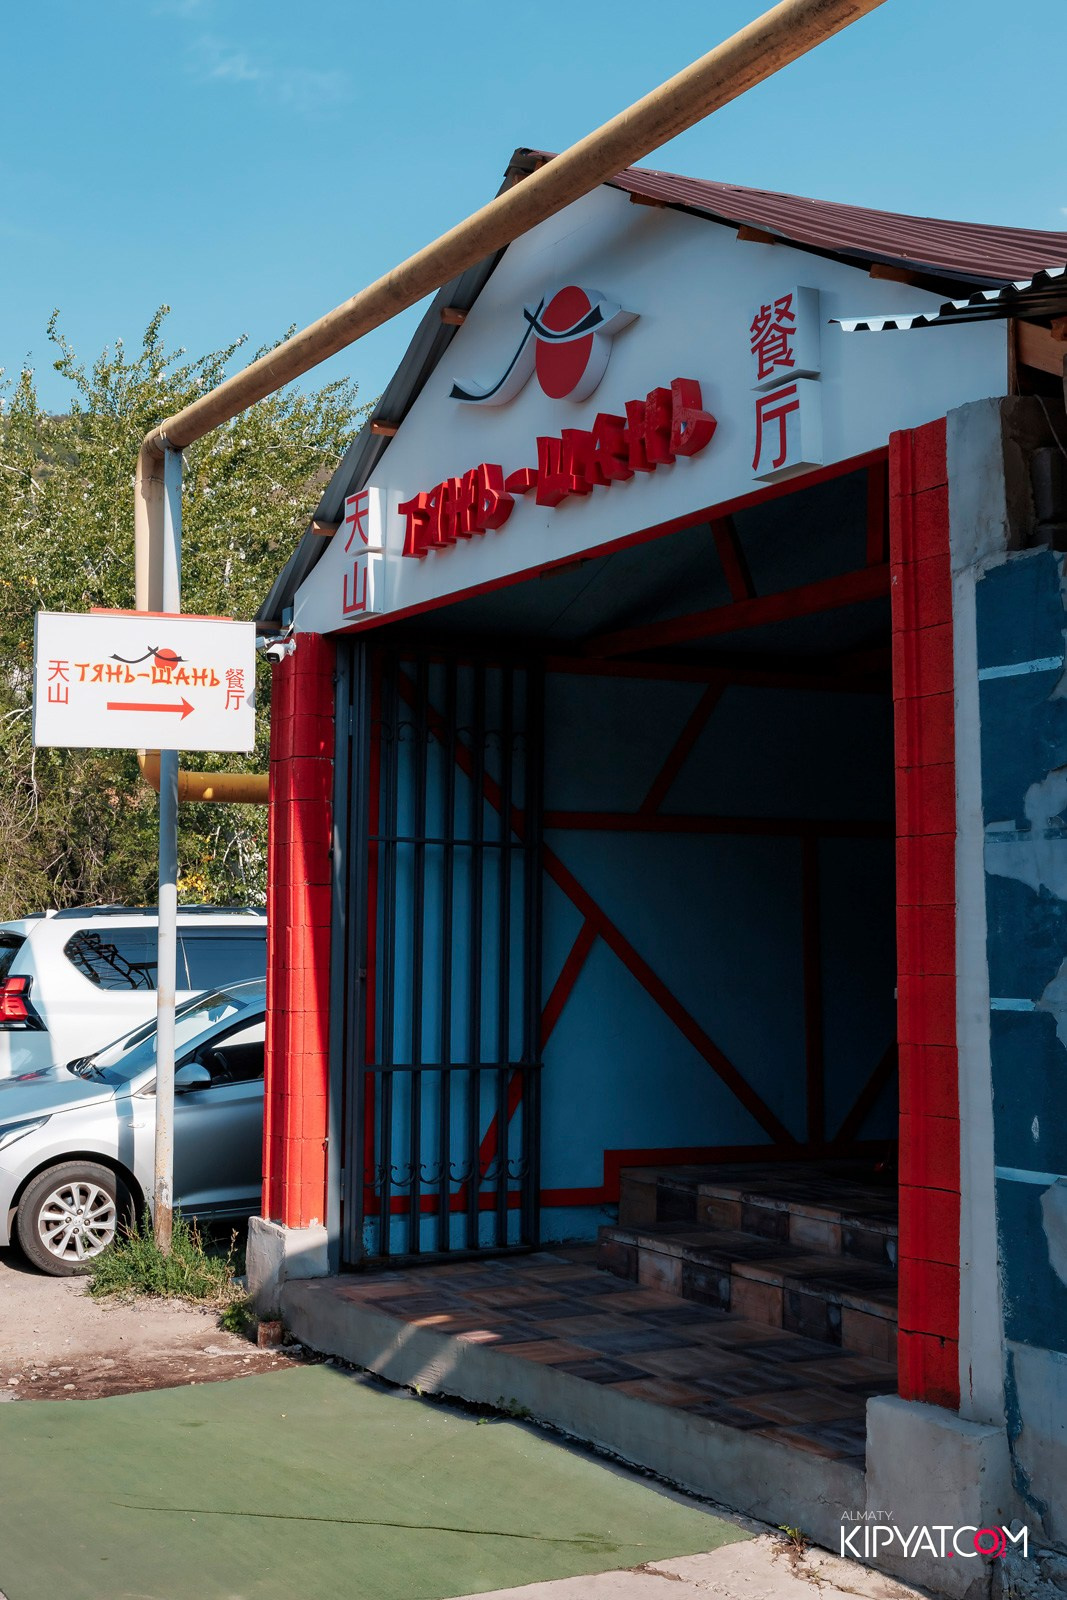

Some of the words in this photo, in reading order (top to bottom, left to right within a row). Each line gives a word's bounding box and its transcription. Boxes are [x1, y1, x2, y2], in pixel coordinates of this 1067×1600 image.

[749, 293, 801, 472] 餐厅
[398, 377, 718, 559] ТЯНЬ-ШАНЬ
[342, 490, 370, 615] 天山
[47, 659, 70, 705] 天山
[74, 662, 221, 688] ТЯНЬ-ШАНЬ
[224, 668, 245, 711] 餐厅
